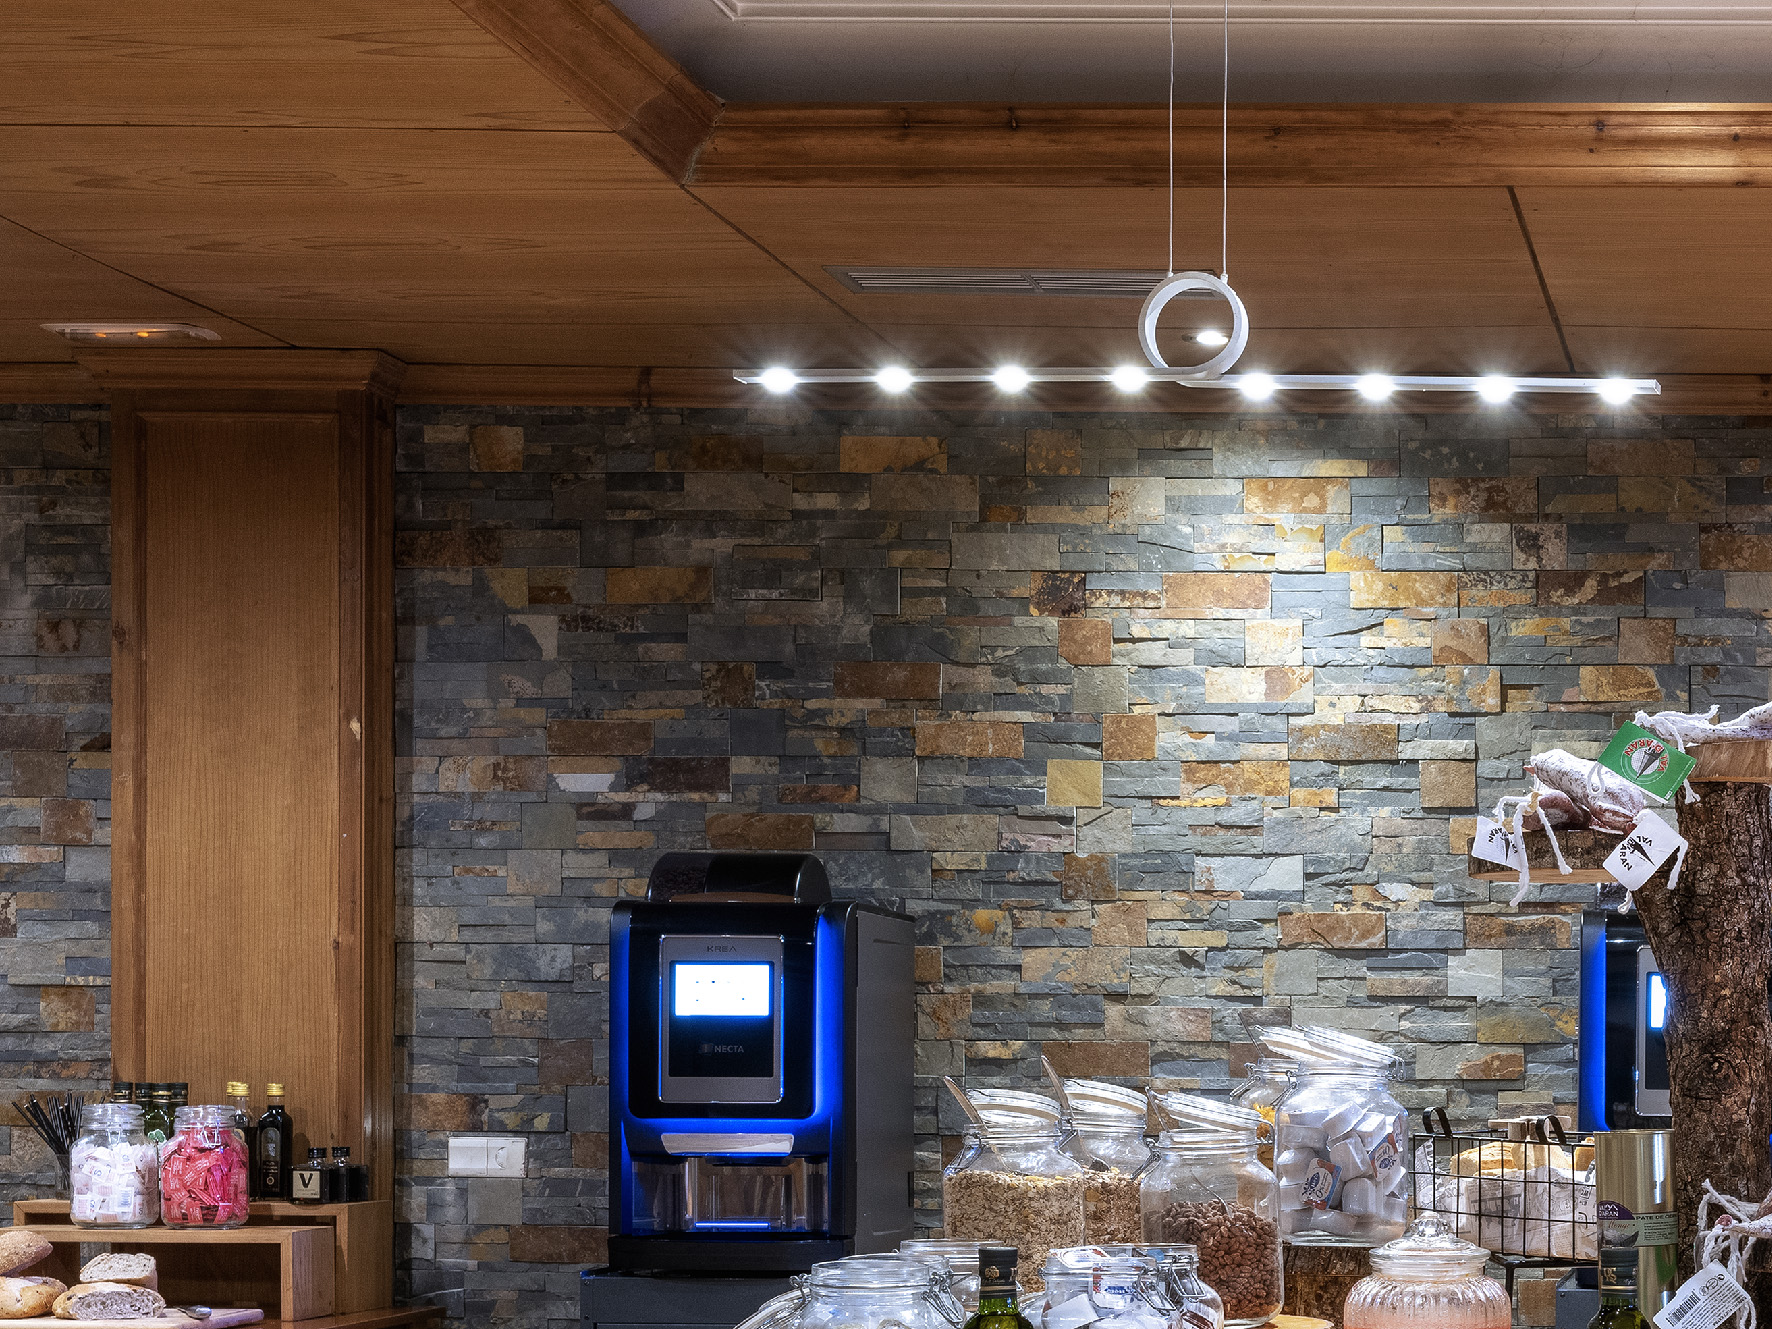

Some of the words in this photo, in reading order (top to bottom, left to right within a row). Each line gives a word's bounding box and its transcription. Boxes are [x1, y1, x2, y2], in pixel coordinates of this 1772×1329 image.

[1623, 739, 1664, 757] D'ARAN
[1657, 754, 1669, 772] VAL
[1636, 834, 1653, 847] VAL
[706, 945, 737, 953] KREA
[714, 1045, 745, 1053] NECTA
[299, 1173, 313, 1188] V
